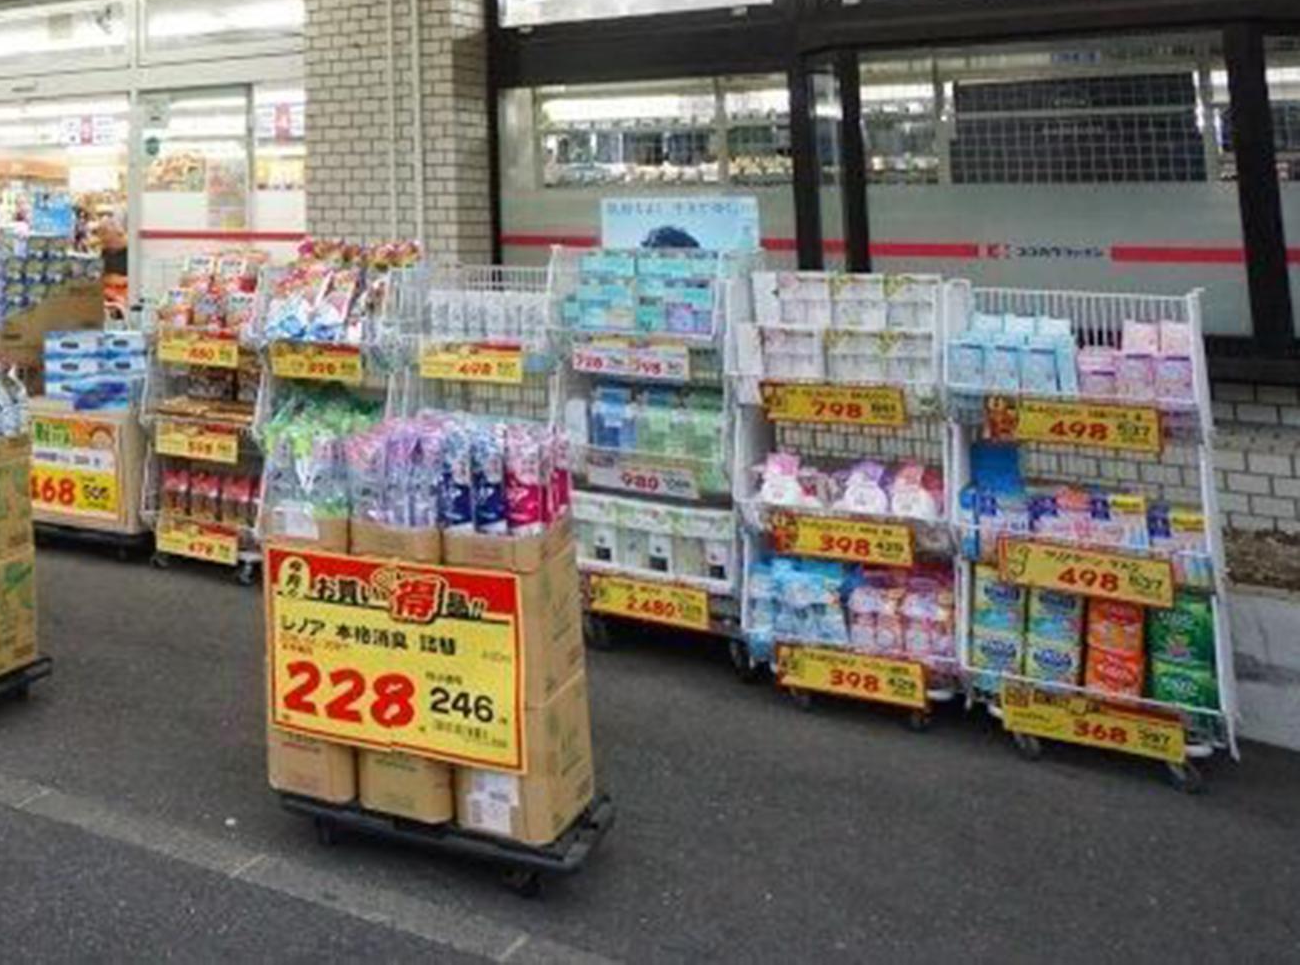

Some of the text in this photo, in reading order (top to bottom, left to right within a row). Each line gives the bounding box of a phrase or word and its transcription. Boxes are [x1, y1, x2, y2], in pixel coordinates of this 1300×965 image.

[811, 398, 862, 418] 798
[1049, 419, 1109, 441] 498
[621, 471, 659, 491] 980
[820, 531, 870, 556] 398
[1057, 566, 1120, 592] 498
[280, 614, 326, 635] レノア
[335, 623, 409, 652] 本格消臭
[829, 668, 880, 692] 398
[282, 659, 495, 729] 228 246
[1073, 718, 1127, 744] 368
